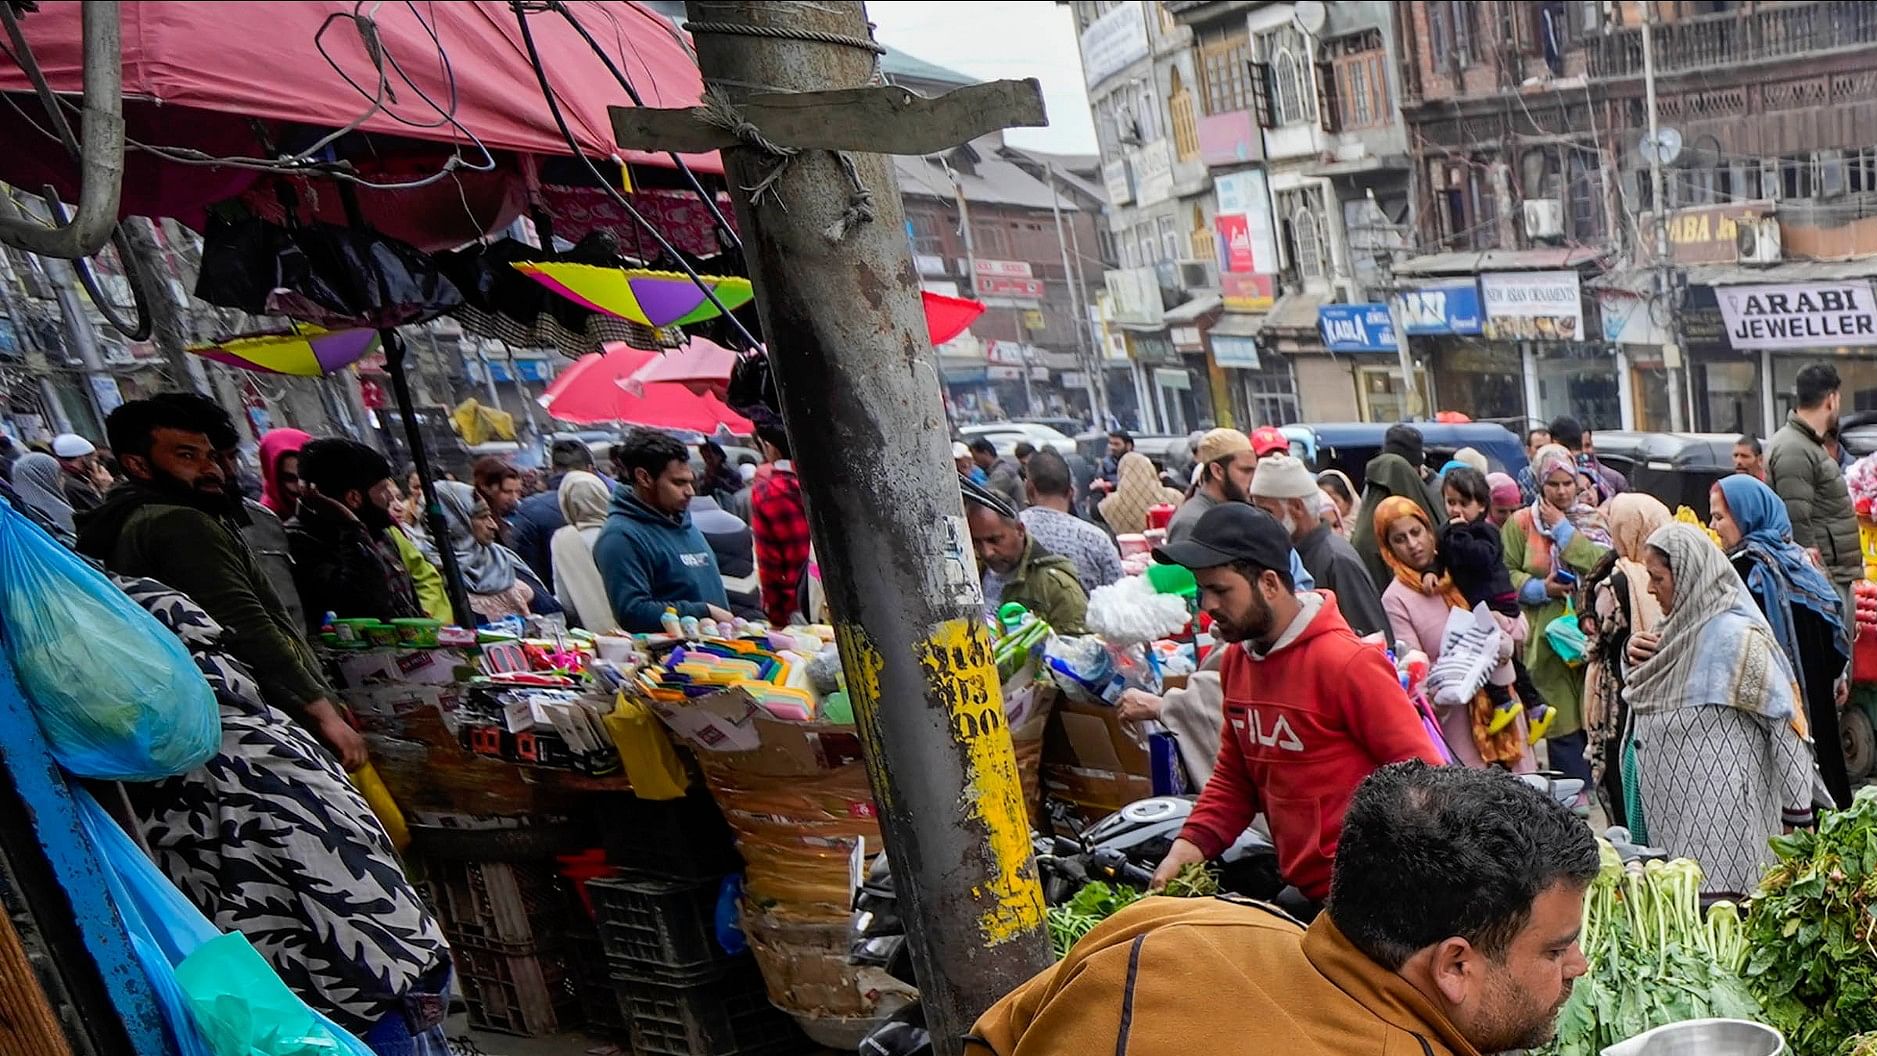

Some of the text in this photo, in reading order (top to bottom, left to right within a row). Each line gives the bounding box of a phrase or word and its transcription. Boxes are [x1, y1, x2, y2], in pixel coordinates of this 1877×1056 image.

[1669, 211, 1711, 243] ABA
[1744, 289, 1859, 316] ARABI
[1735, 314, 1875, 339] JEWELLER
[1230, 707, 1305, 752] FILA
